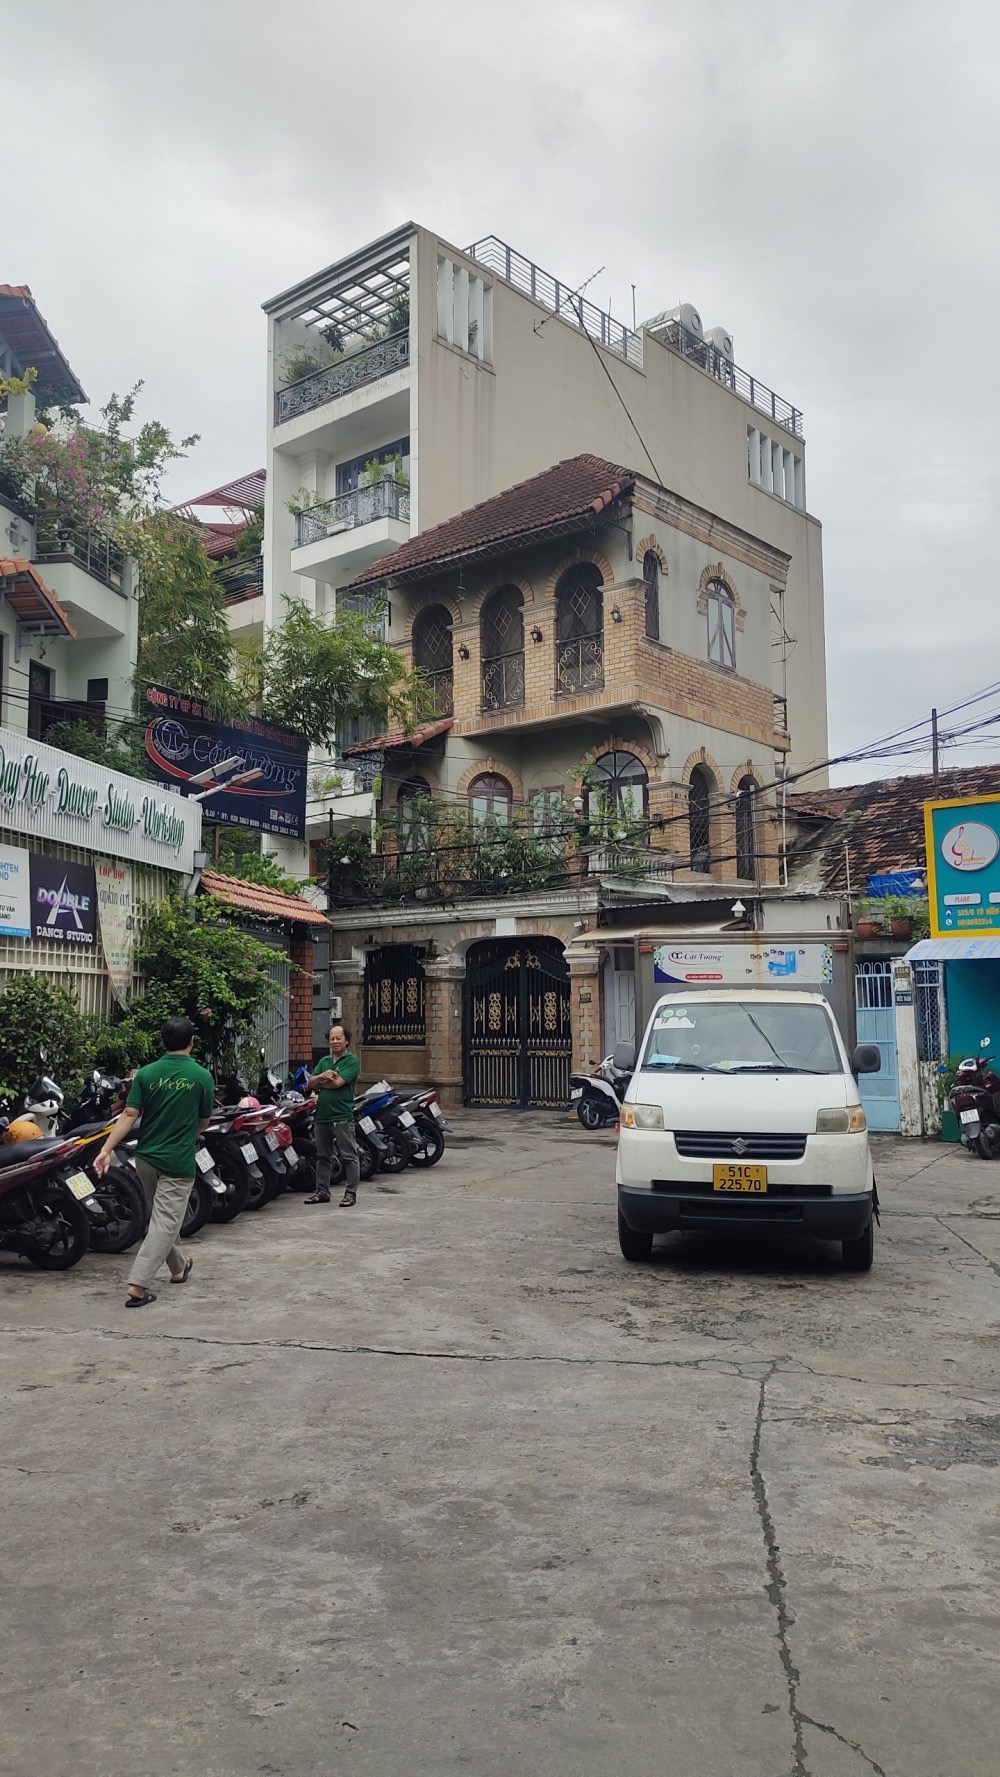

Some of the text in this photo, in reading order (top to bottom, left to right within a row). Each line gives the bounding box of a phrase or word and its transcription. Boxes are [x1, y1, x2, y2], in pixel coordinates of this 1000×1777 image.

[146, 686, 168, 707] CÔNG
[169, 695, 179, 709] TY
[22, 755, 50, 815] Học
[57, 767, 98, 819] Dancer
[36, 886, 91, 911] DOUBLE
[36, 925, 64, 939] DANCE
[66, 930, 93, 943] STUDIO
[684, 952, 698, 960] Cát
[728, 1166, 751, 1178] 51C
[719, 1178, 762, 1191] 225.70
